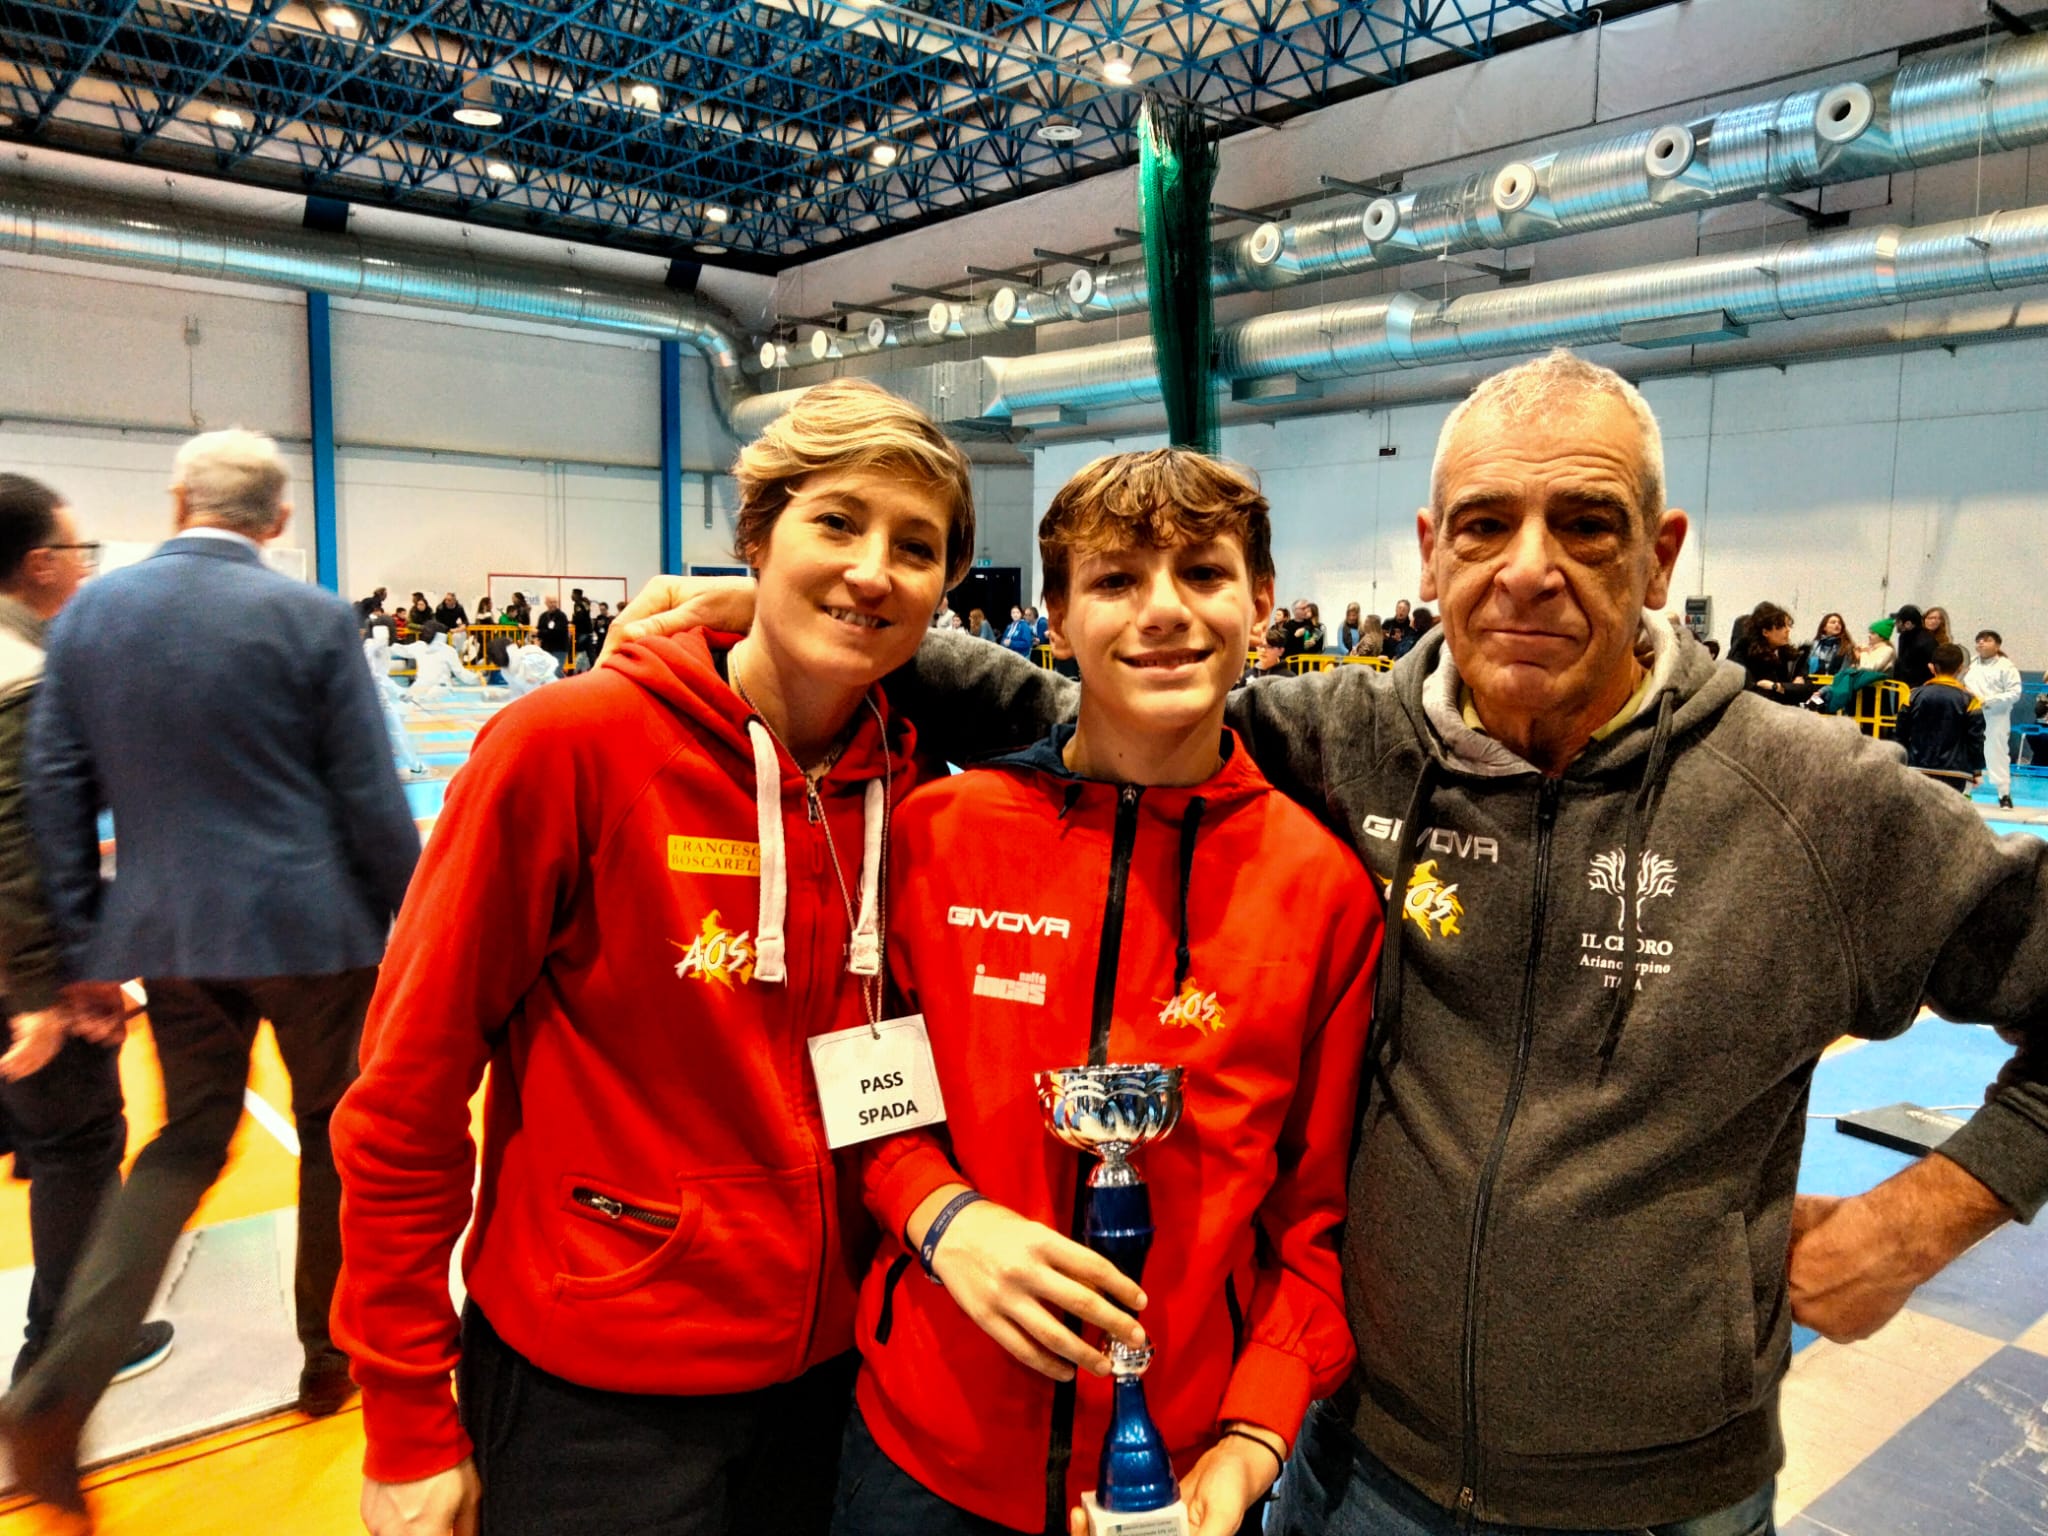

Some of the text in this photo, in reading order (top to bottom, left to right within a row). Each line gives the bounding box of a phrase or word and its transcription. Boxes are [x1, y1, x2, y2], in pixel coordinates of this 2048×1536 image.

[673, 839, 760, 857] FRANCESC
[672, 854, 759, 871] BOSCAREL
[947, 905, 1071, 939] GIVOVA
[1580, 933, 1602, 948] IL
[674, 929, 751, 980] AOS
[1634, 961, 1672, 976] rpino
[972, 963, 1047, 1006] incas
[1158, 991, 1217, 1025] AOS
[860, 1071, 904, 1094] PASS
[858, 1099, 919, 1126] SPADA
